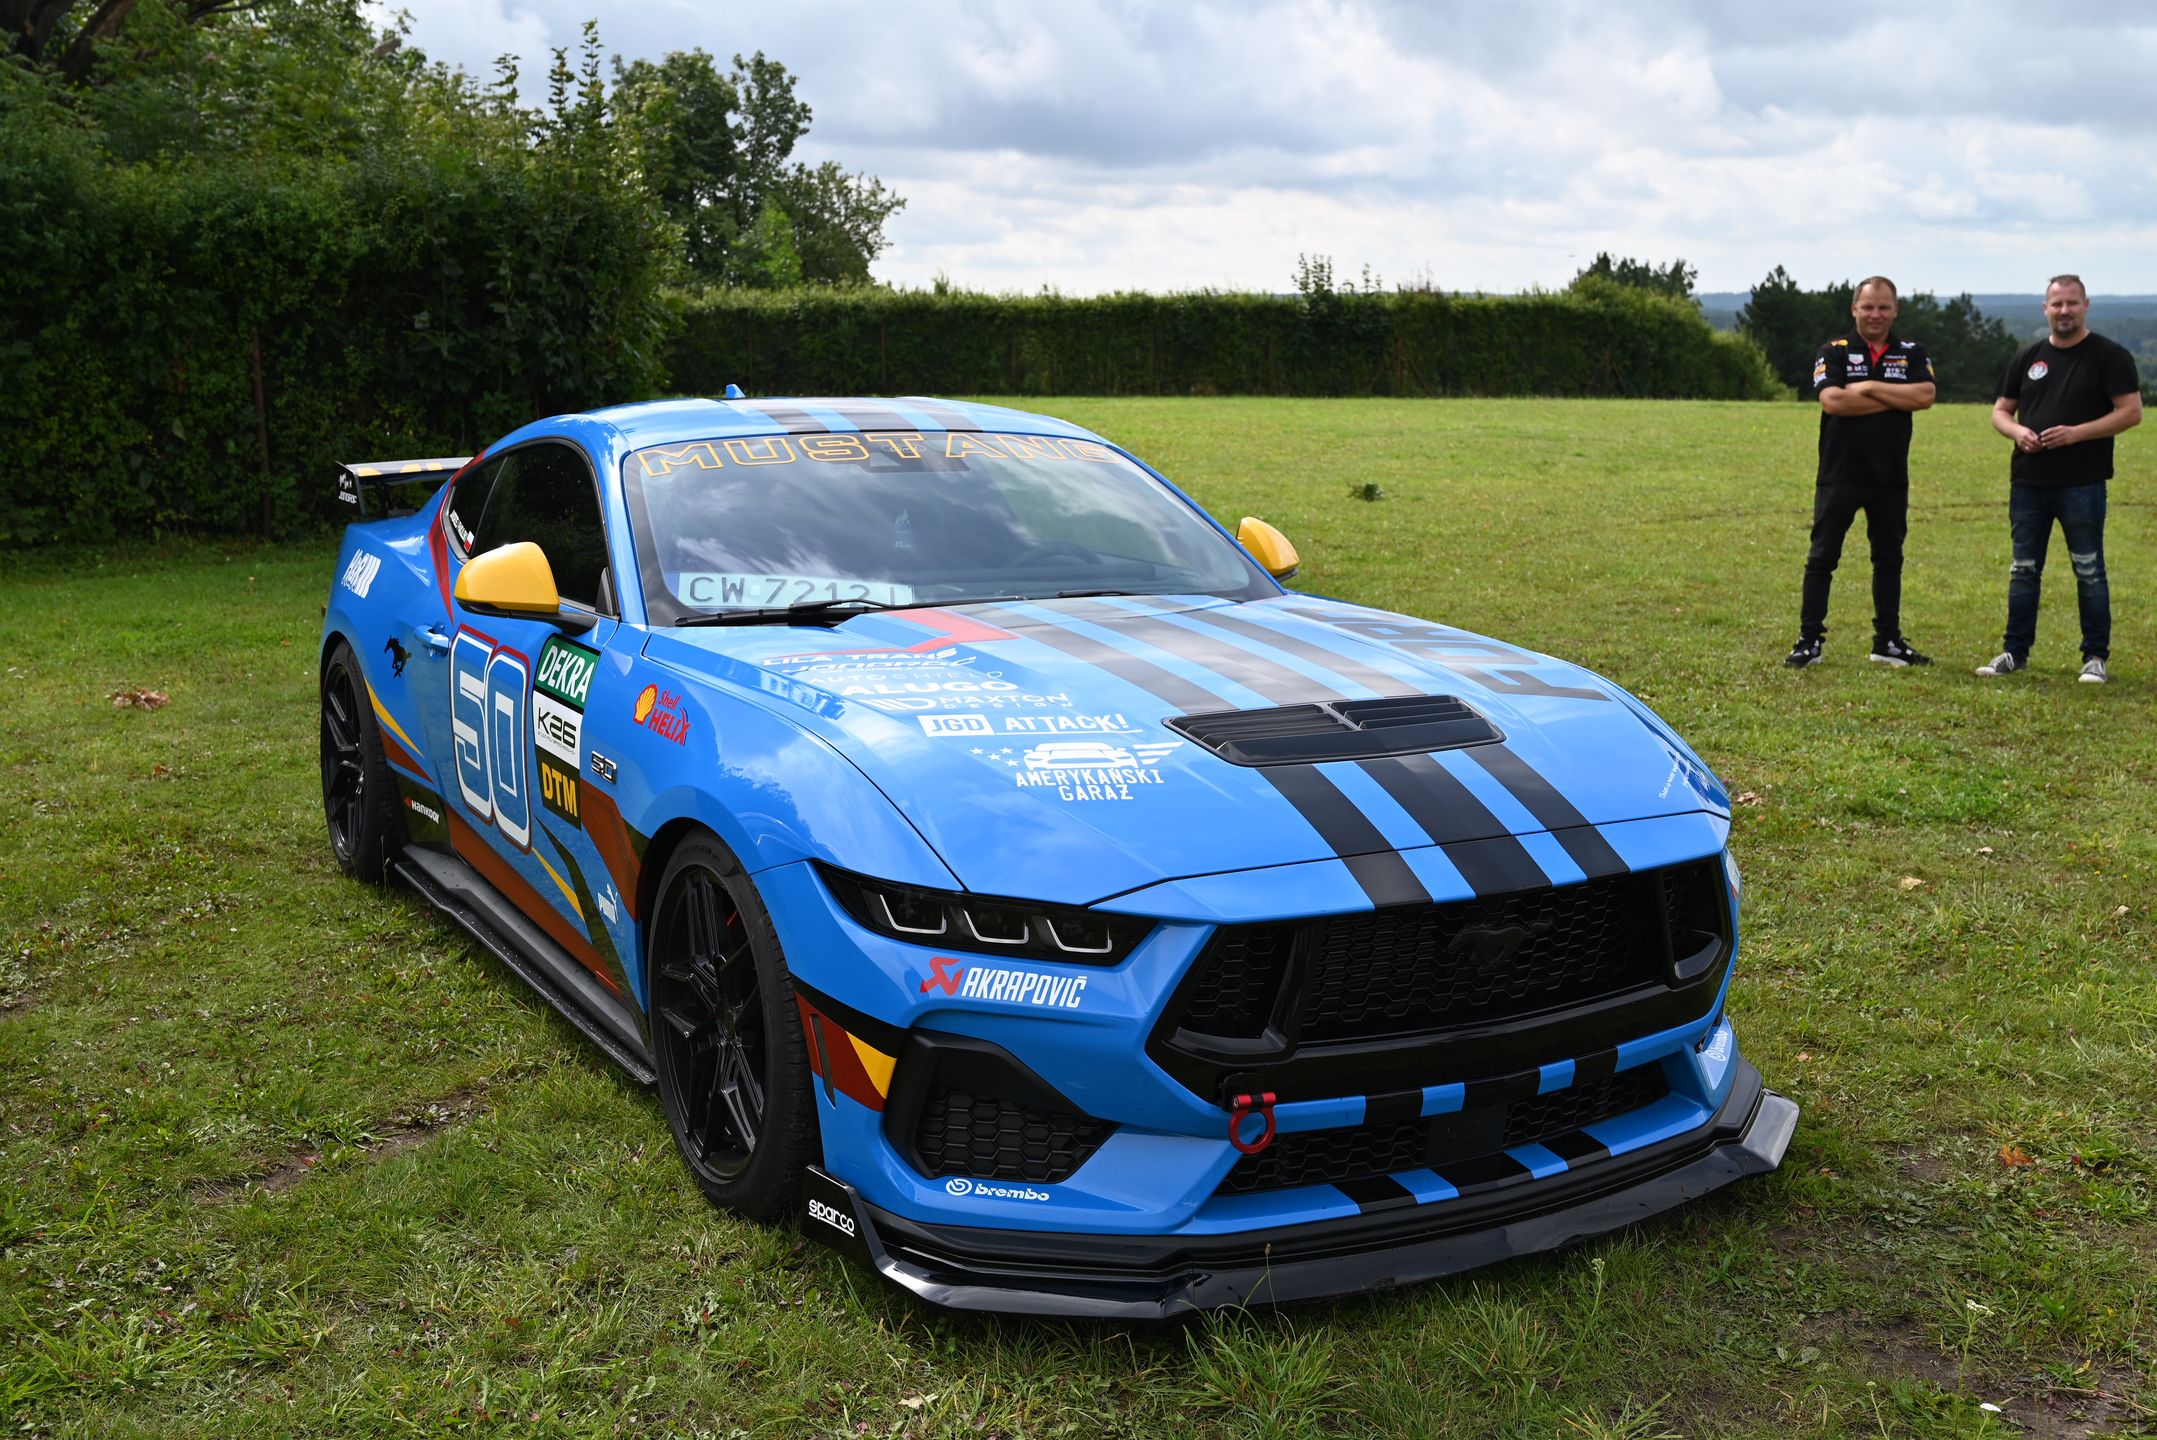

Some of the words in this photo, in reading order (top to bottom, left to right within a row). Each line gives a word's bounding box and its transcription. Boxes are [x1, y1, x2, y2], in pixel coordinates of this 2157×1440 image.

[639, 433, 1120, 477] MUSTANG
[689, 576, 745, 603] CW
[538, 645, 594, 703] DEKRA
[763, 654, 833, 666] LILA
[846, 647, 957, 660] TRANS
[657, 690, 681, 711] Shell
[840, 680, 1019, 696] ALUGO
[938, 693, 1070, 704] MAXTON
[449, 625, 531, 852] 50
[538, 706, 577, 750] K26
[647, 708, 691, 747] HELIX
[930, 717, 985, 732] JGD
[1004, 713, 1129, 733] ATTACK!
[541, 762, 578, 818] DTM
[961, 967, 1088, 1008] AKRAPOVIČ
[974, 1183, 1050, 1202] brembo
[808, 1198, 855, 1233] sparco
